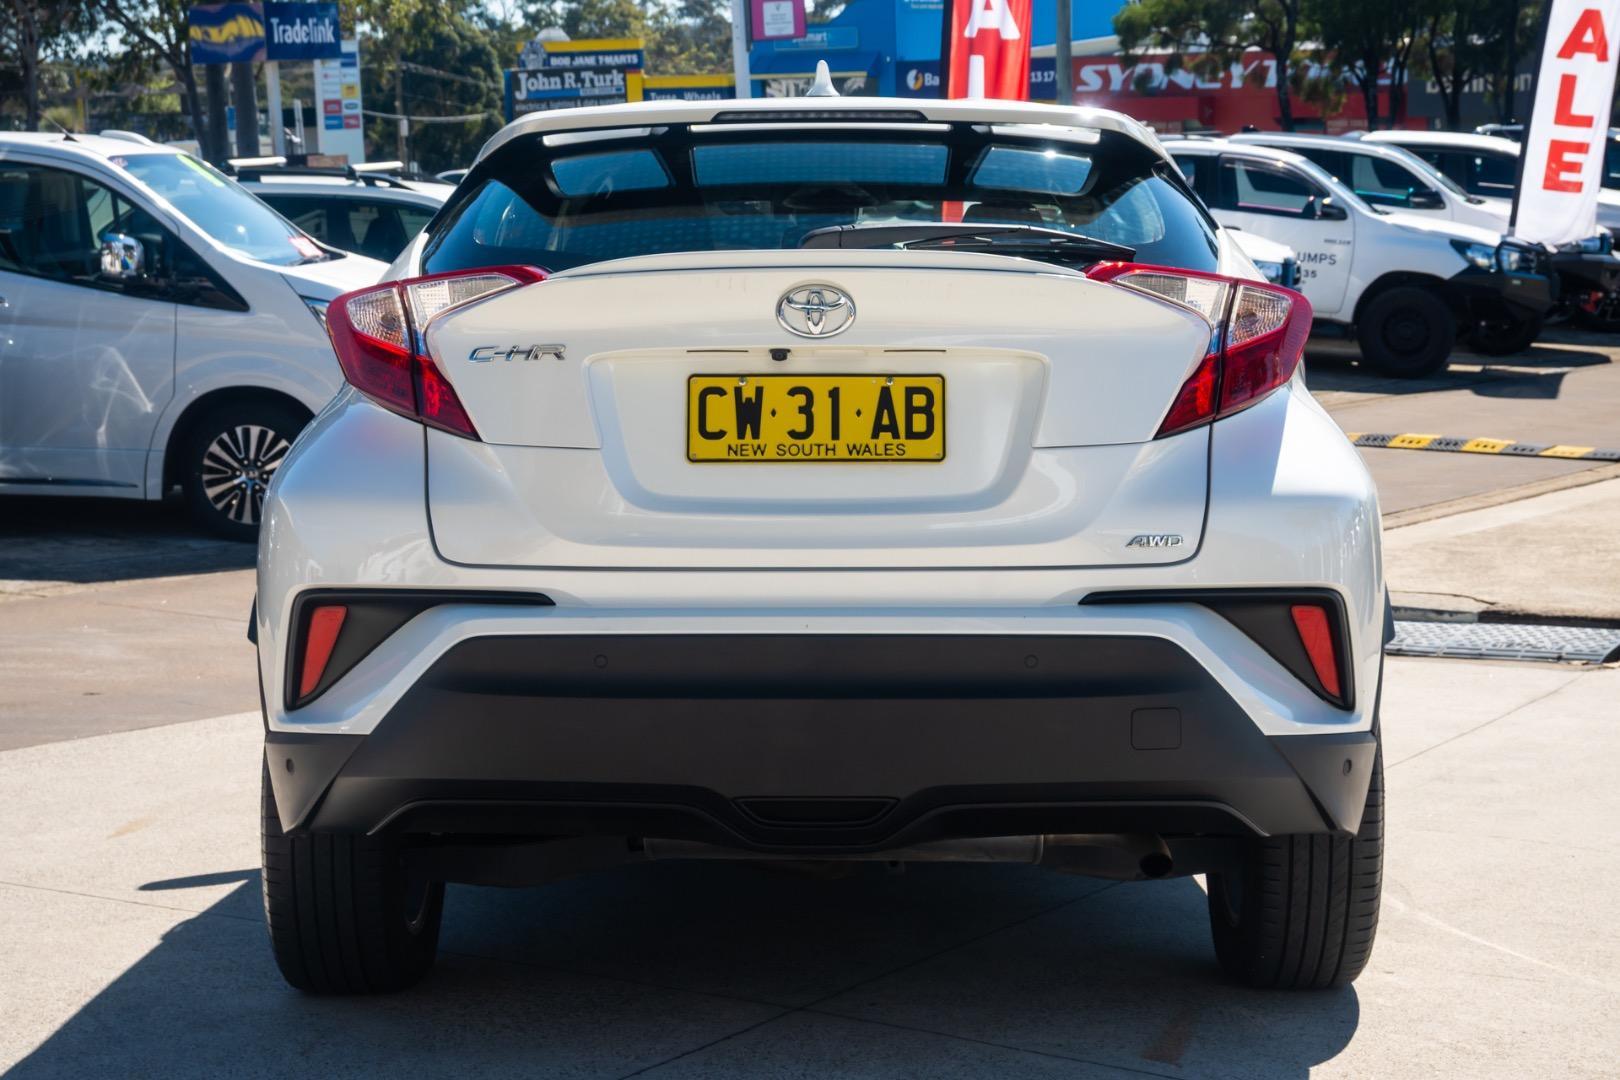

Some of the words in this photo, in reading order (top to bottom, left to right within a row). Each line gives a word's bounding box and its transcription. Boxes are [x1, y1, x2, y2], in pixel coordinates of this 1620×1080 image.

[270, 17, 336, 44] Tradelink
[514, 72, 562, 100] John
[581, 69, 625, 88] Turk
[683, 90, 721, 100] Wheels
[468, 344, 566, 362] C-HR
[727, 443, 767, 457] NEW
[776, 443, 836, 457] SOUTH
[846, 443, 906, 457] WALES
[1125, 535, 1183, 547] AWD
